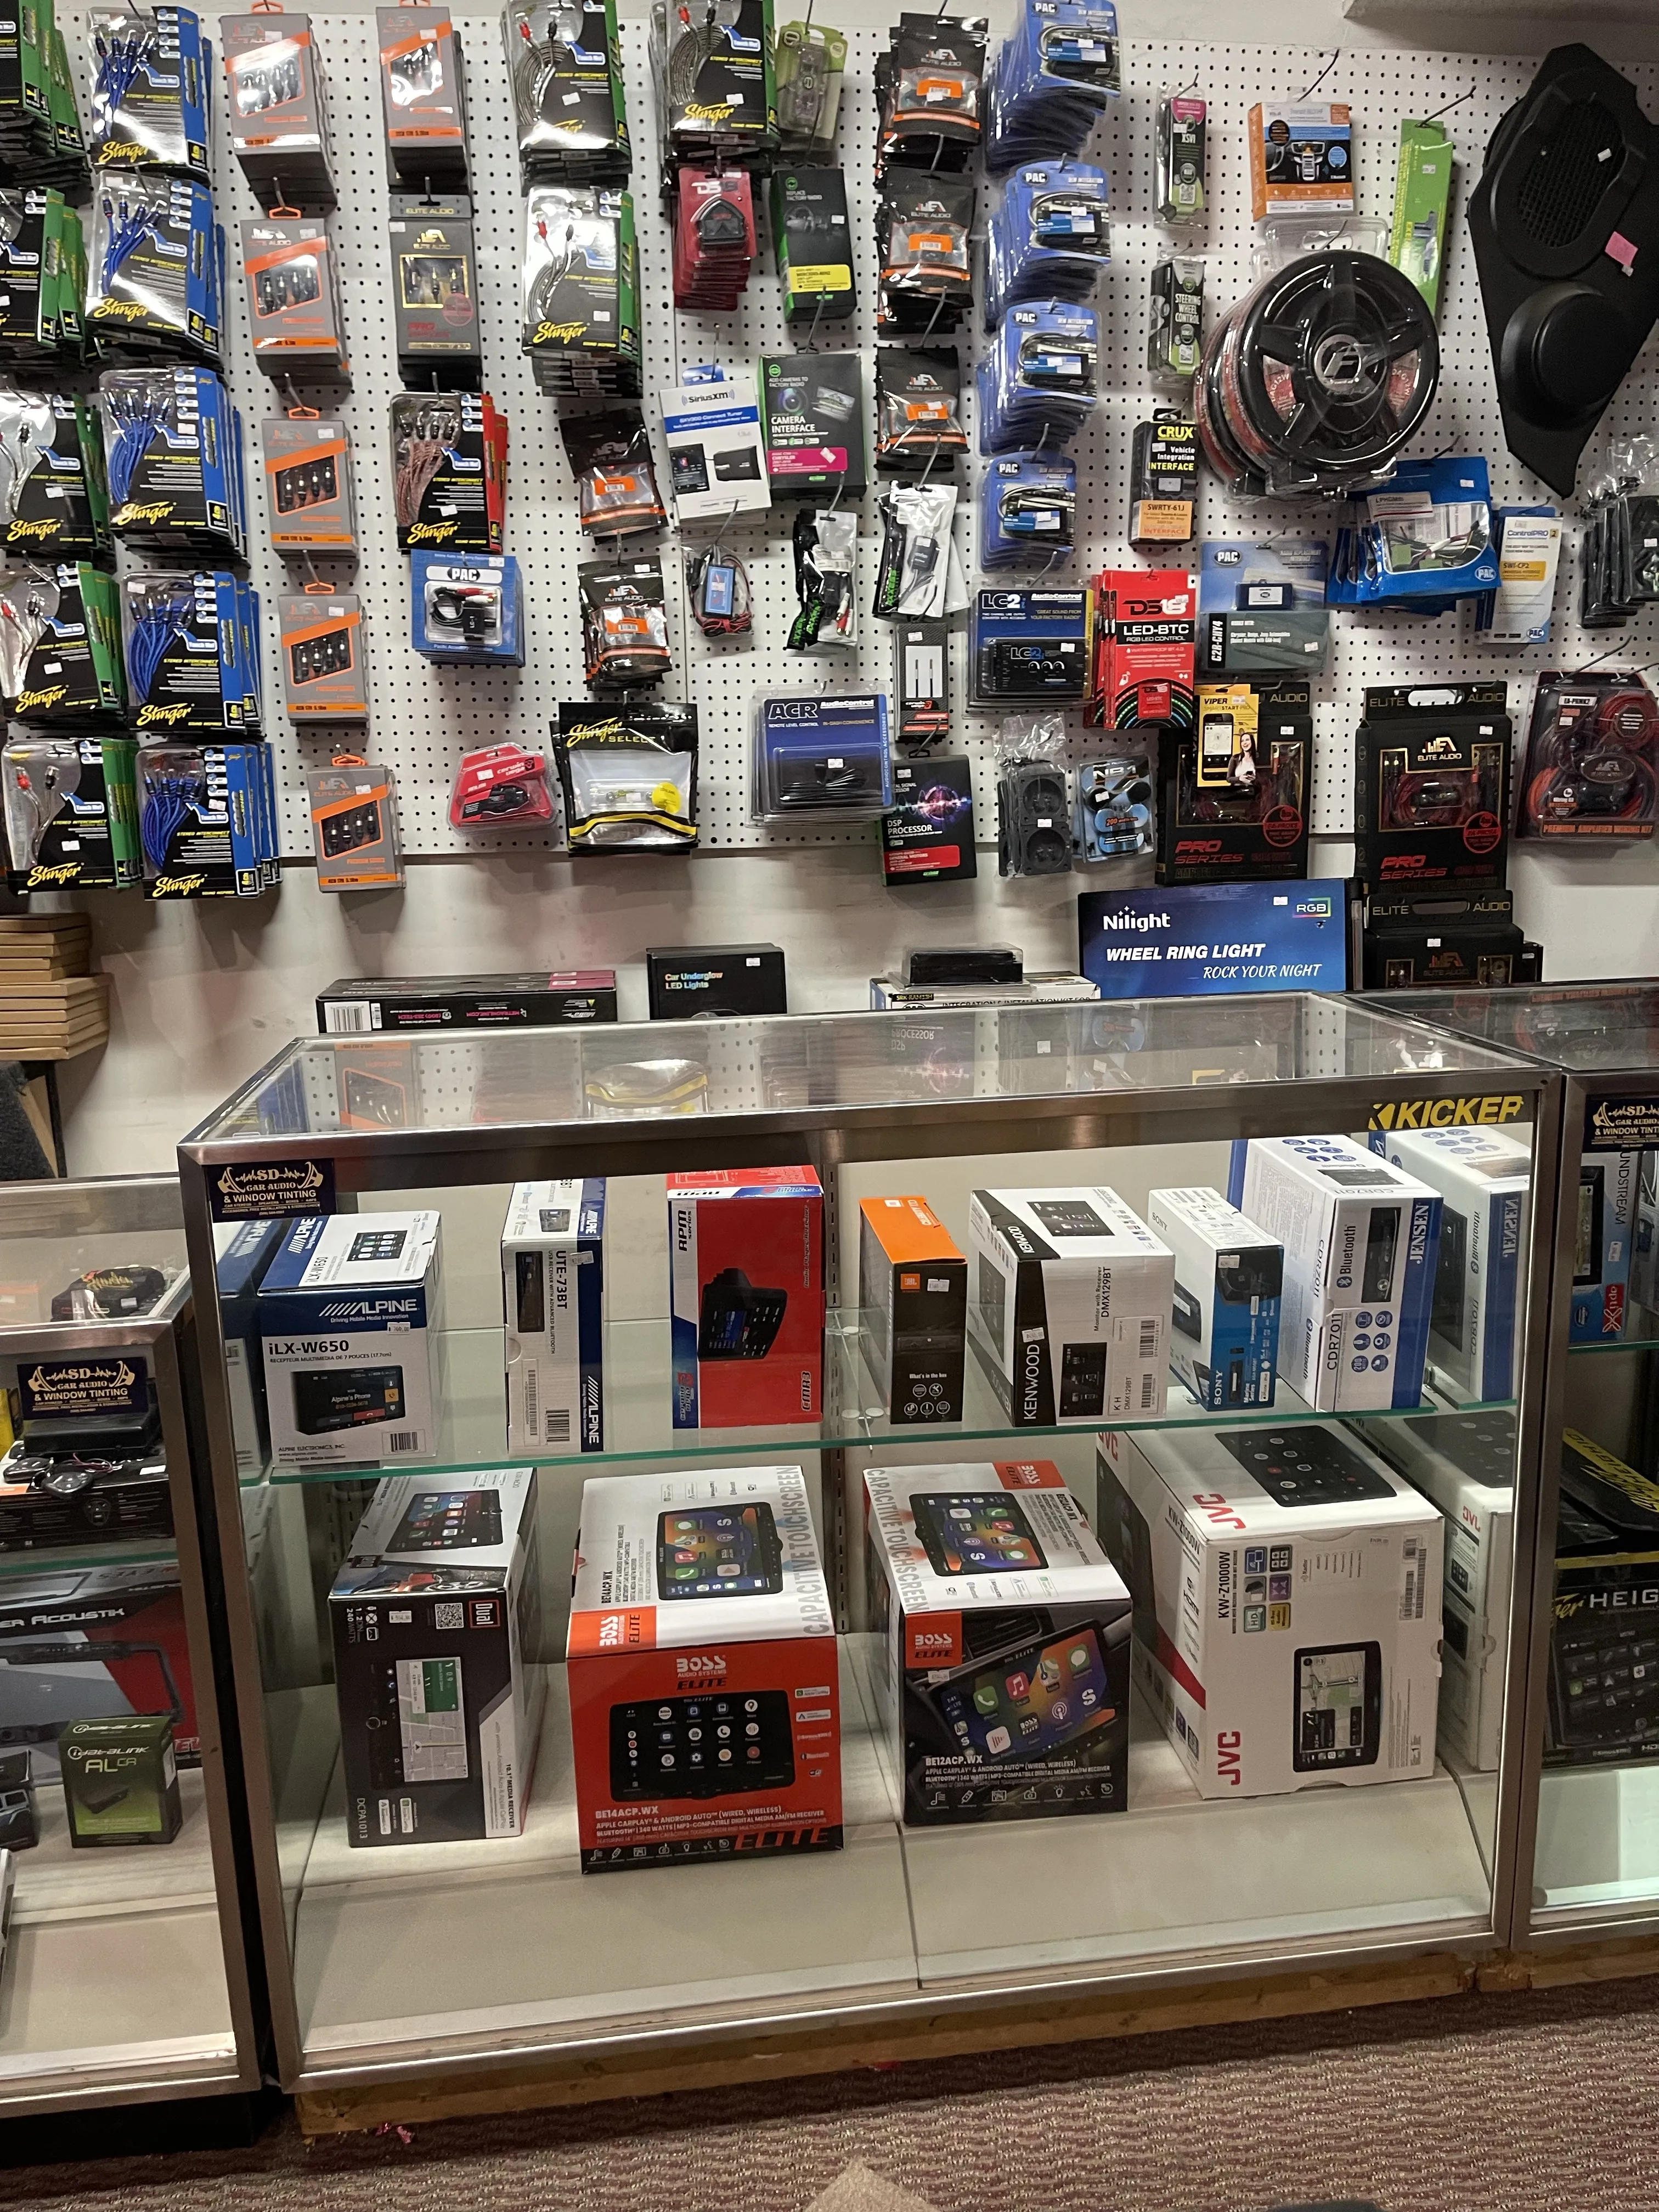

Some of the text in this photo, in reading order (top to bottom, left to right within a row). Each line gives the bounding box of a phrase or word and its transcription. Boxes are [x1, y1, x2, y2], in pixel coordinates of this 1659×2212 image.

[1035, 3, 1056, 13] PAC
[684, 104, 736, 125] Stinger
[1181, 134, 1195, 143] XSVI
[99, 141, 149, 163] Stinger
[1025, 172, 1045, 183] PAC
[691, 182, 738, 194] DS18
[1175, 294, 1201, 303] STEERING
[94, 297, 149, 318] Stinger
[1178, 303, 1198, 314] WHEEL
[1016, 313, 1035, 323] PAC
[1175, 313, 1200, 324] CONTROL
[533, 322, 586, 343] Stinger
[771, 415, 805, 425] CAMERA
[772, 424, 815, 433] INTERFACE
[1158, 426, 1194, 439] CRUX
[1000, 464, 1018, 473] PAC
[1148, 462, 1194, 471] INTERFACE
[118, 501, 174, 526] Stinger
[7, 518, 61, 541] Stinger
[407, 522, 459, 544] Stinger
[1507, 529, 1548, 538] ControlPRO
[1218, 551, 1239, 562] PAC
[451, 568, 477, 581] PAC
[1477, 568, 1494, 579] PAC
[1031, 593, 1082, 602] AudioControl
[1122, 599, 1187, 616] DS18
[1124, 624, 1189, 636] LED-BTC
[1211, 620, 1223, 662] C2R-CHY4
[15, 685, 67, 712] Stinger
[820, 699, 874, 709] AudioControl
[1270, 692, 1308, 702] AUDIO
[1370, 692, 1505, 707] ELITE AUDIO
[136, 703, 193, 725] Stinger
[769, 702, 817, 720] ACR
[888, 825, 933, 835] PROCESSOR
[1175, 840, 1222, 853] PRO
[1174, 854, 1244, 864] SERIES
[1380, 855, 1426, 869] PRO
[27, 862, 82, 887] Stinger
[1379, 868, 1448, 880] SERIES
[153, 874, 205, 898] Stinger
[1296, 903, 1327, 915] RGB
[1372, 902, 1511, 916] ELITE AUDIO
[1103, 911, 1171, 932] Nilight
[1106, 943, 1266, 961] WHEEL RING LIGHT
[681, 972, 723, 981] Underglow
[1203, 963, 1322, 978] ROCK YOUR NIGHT
[683, 980, 709, 990] Lights
[1397, 1096, 1523, 1130] KICKER
[1626, 1104, 1646, 1117] SD
[257, 1169, 279, 1180] SD
[233, 1193, 275, 1203] WINDOW
[277, 1190, 316, 1199] TINTING
[1152, 1213, 1168, 1231] SONY
[678, 1210, 688, 1252] RPM
[1410, 1204, 1429, 1263] JENSEN
[1008, 1226, 1035, 1254] KENWOOD
[1340, 1224, 1356, 1274] Bluetooth
[1314, 1239, 1324, 1298] CDR7011
[555, 1250, 568, 1310] UTE-73BT
[1101, 1266, 1111, 1318] DMX129BT
[269, 1340, 349, 1355] iLX-W650
[1327, 1313, 1341, 1370] CDR7011
[69, 1368, 91, 1380] SD
[1024, 1344, 1040, 1420] KENWOOD
[79, 1380, 107, 1389] AUDIO
[1214, 1370, 1223, 1405] SONY
[43, 1387, 128, 1400] WINDOW TINTING
[1020, 1465, 1041, 1485] BOSS
[776, 1466, 814, 1551] TOUCHSCREEN
[1193, 1493, 1246, 1530] JVC
[1168, 1505, 1200, 1555] KW-Z1000W
[867, 1469, 930, 1612] CAPACITIVE TOUCHSCREEN
[601, 1571, 612, 1604] BE14ACP.WX
[792, 1551, 830, 1635] CAPACITIVE
[1218, 1551, 1231, 1619] KW-Z1000W
[31, 1608, 125, 1625] ACOUSTIK
[473, 1602, 493, 1627] Dual
[600, 1615, 618, 1646] BOSS
[629, 1614, 640, 1643] ELITE
[915, 1633, 952, 1646] BOSS
[915, 1649, 952, 1658] ELITE
[676, 1656, 726, 1673] BOSS
[676, 1678, 727, 1690] ELITE
[926, 1756, 983, 1766] BE12ACP.WX
[1025, 1762, 1047, 1770] (WIRED,
[1048, 1759, 1076, 1768] WIRELESS)
[1217, 1730, 1241, 1786] JVC
[357, 1797, 368, 1839] DCPA1013
[595, 1805, 659, 1819] BE14ACP.WX
[596, 1805, 782, 1829] APPLE ANDROID (WIRED, WIRELESS)
[652, 1823, 673, 1832] WATTS
[731, 1816, 754, 1825] DIGITAL
[754, 1814, 774, 1822] MEDIA
[775, 1812, 797, 1821] AM/FM
[797, 1810, 825, 1819] RECEIVER
[734, 1826, 829, 1851] ELITE
